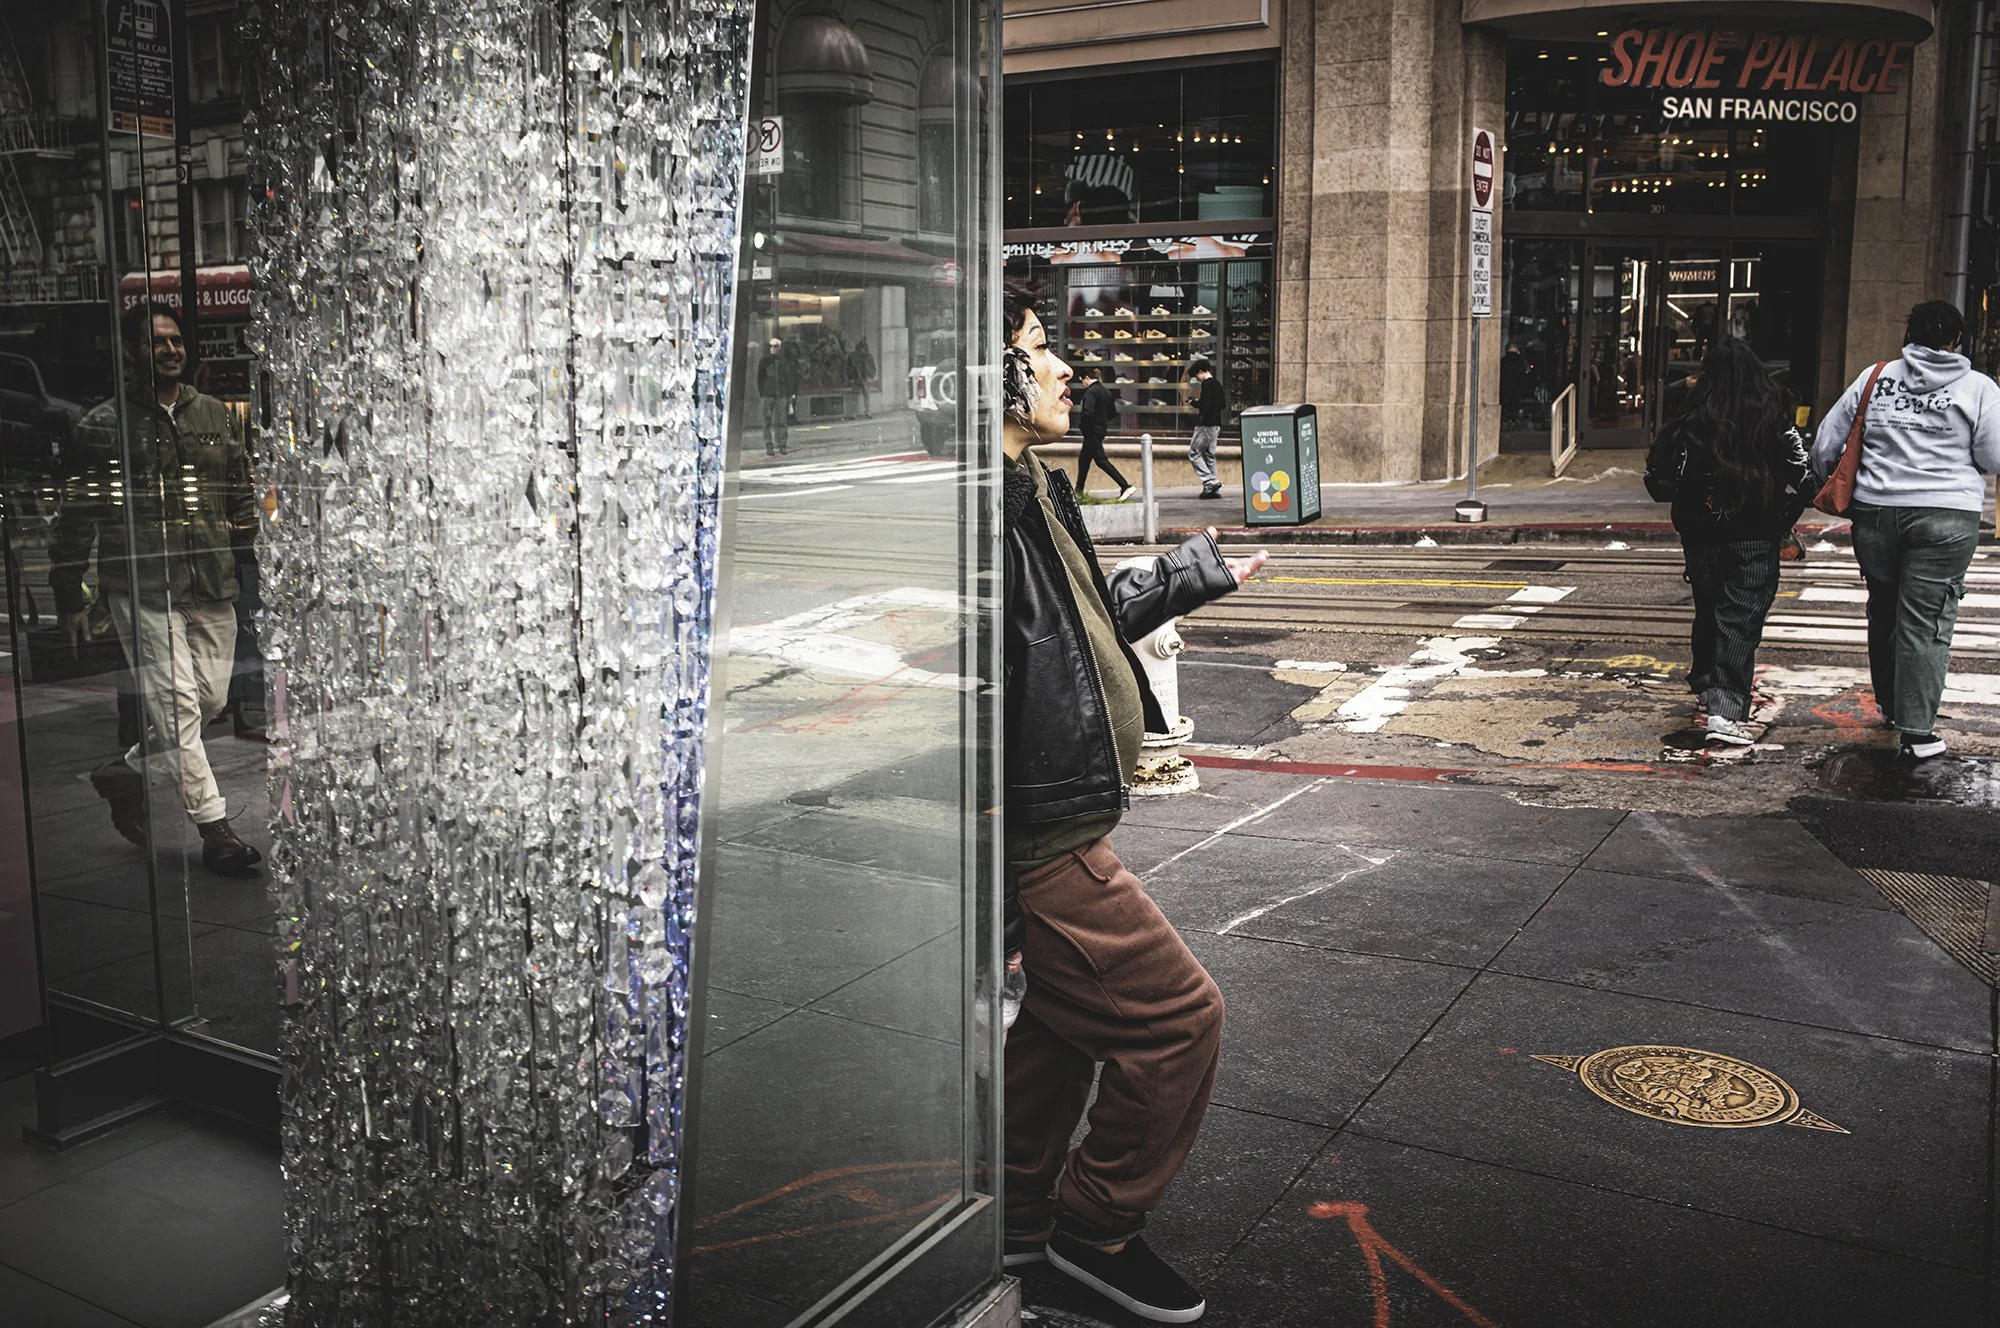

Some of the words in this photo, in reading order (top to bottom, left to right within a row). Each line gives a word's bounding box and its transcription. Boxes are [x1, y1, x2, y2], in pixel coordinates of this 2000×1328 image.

[128, 39, 151, 52] CBLE
[1601, 27, 1737, 90] SHOE
[1736, 32, 1913, 94] PALACE
[1661, 96, 1712, 119] SAN
[1719, 97, 1858, 124] FRANCISCO
[1475, 145, 1481, 157] DO
[1483, 147, 1491, 159] NOT
[1476, 179, 1488, 192] ENTER
[1650, 204, 1666, 214] 301
[1669, 270, 1717, 282] WOMENS
[203, 291, 212, 306] &
[197, 342, 234, 357] QUARE
[1252, 436, 1283, 445] SQUARE
